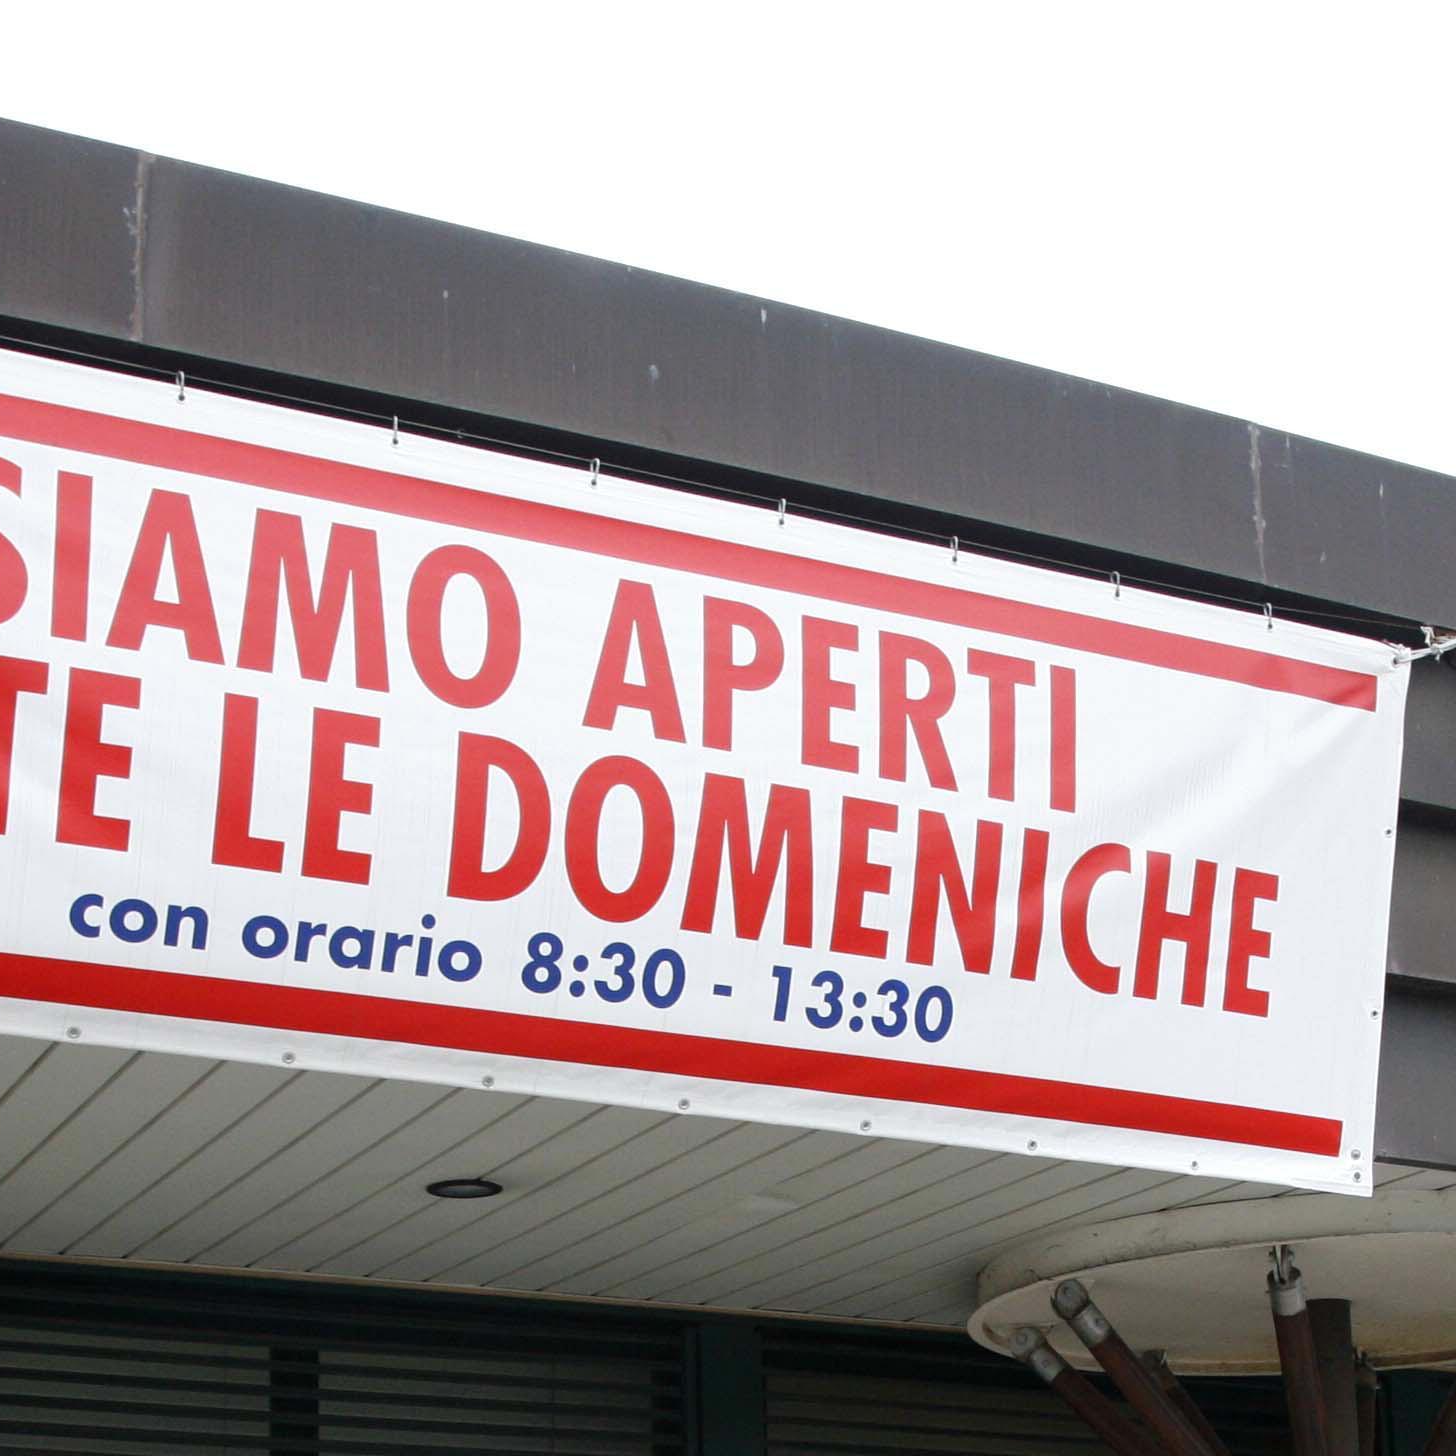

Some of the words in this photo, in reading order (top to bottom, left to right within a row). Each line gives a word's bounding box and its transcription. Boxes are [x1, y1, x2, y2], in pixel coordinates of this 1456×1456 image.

[584, 579, 1078, 814] APERTI
[68, 892, 210, 951] con
[240, 912, 484, 984] orario
[520, 930, 687, 1010] 8:30
[771, 964, 955, 1044] 13:30
[211, 692, 381, 886] LE
[447, 731, 1279, 1018] DOMENICHE
